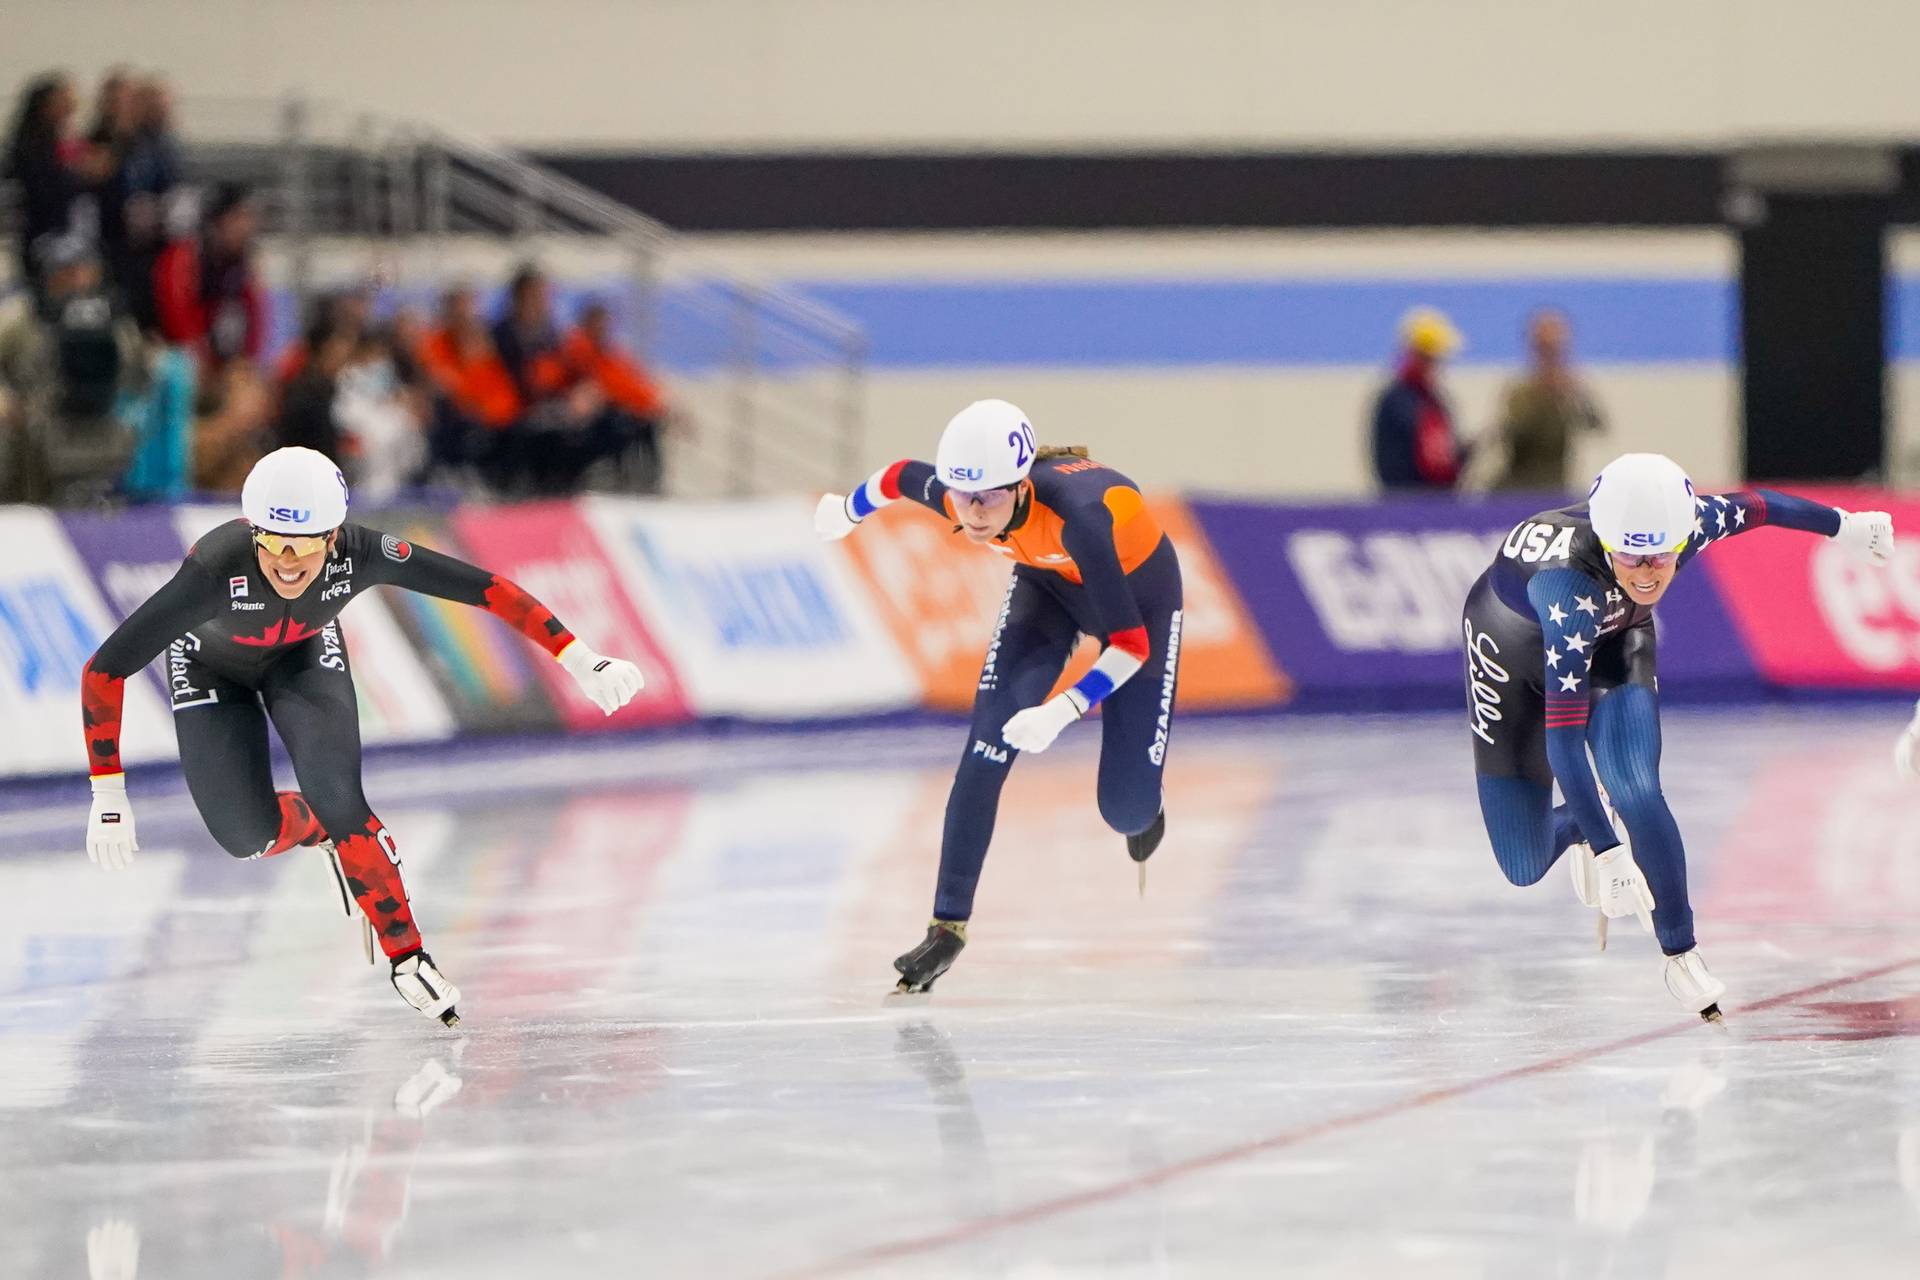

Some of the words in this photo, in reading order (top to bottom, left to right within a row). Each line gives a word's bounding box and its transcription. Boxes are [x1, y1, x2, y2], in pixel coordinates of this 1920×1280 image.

[1503, 520, 1577, 563] USA
[231, 600, 265, 611] Svante
[1154, 609, 1183, 745] ZAANLANDER
[1464, 617, 1510, 745] Lilly
[973, 740, 1008, 763] FILA
